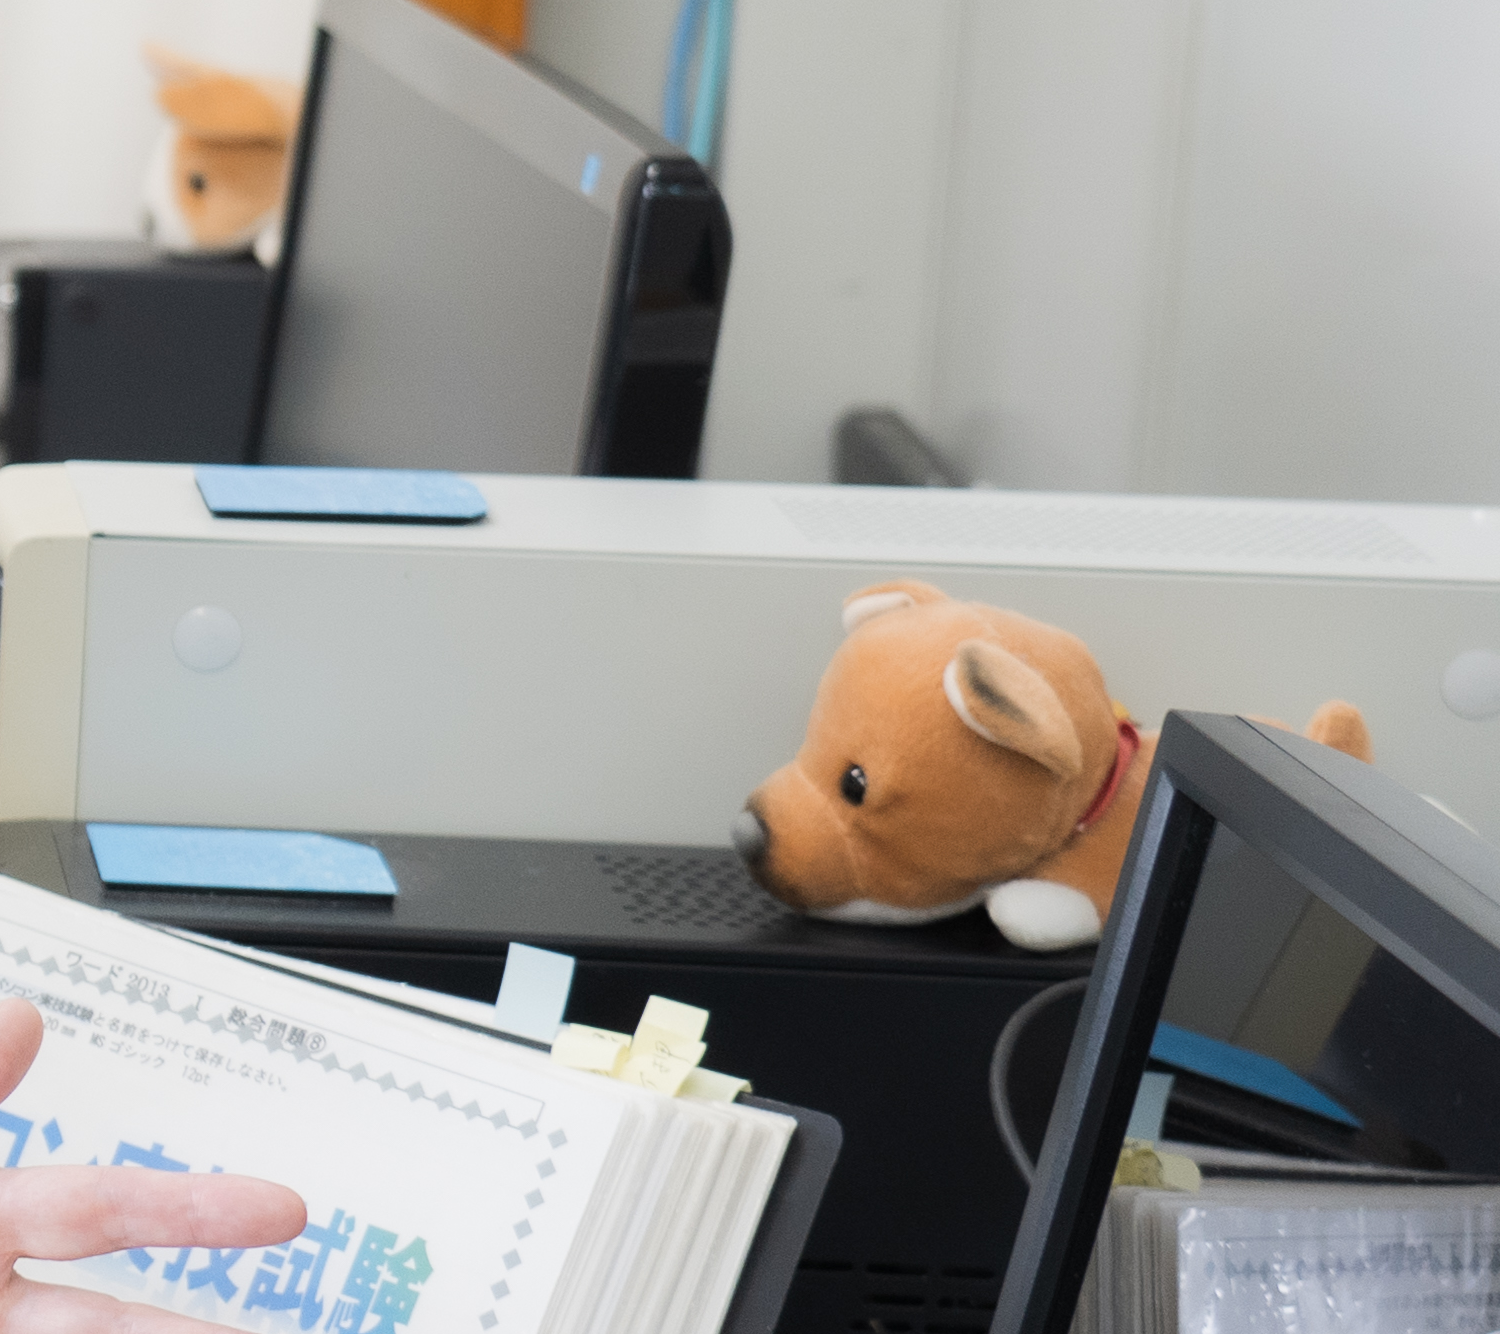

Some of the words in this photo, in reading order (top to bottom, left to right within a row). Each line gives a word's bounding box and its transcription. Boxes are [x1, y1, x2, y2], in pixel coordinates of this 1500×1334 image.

[63, 950, 124, 985] ワード
[125, 971, 171, 1001] 2013
[181, 1064, 211, 1086] 12pt
